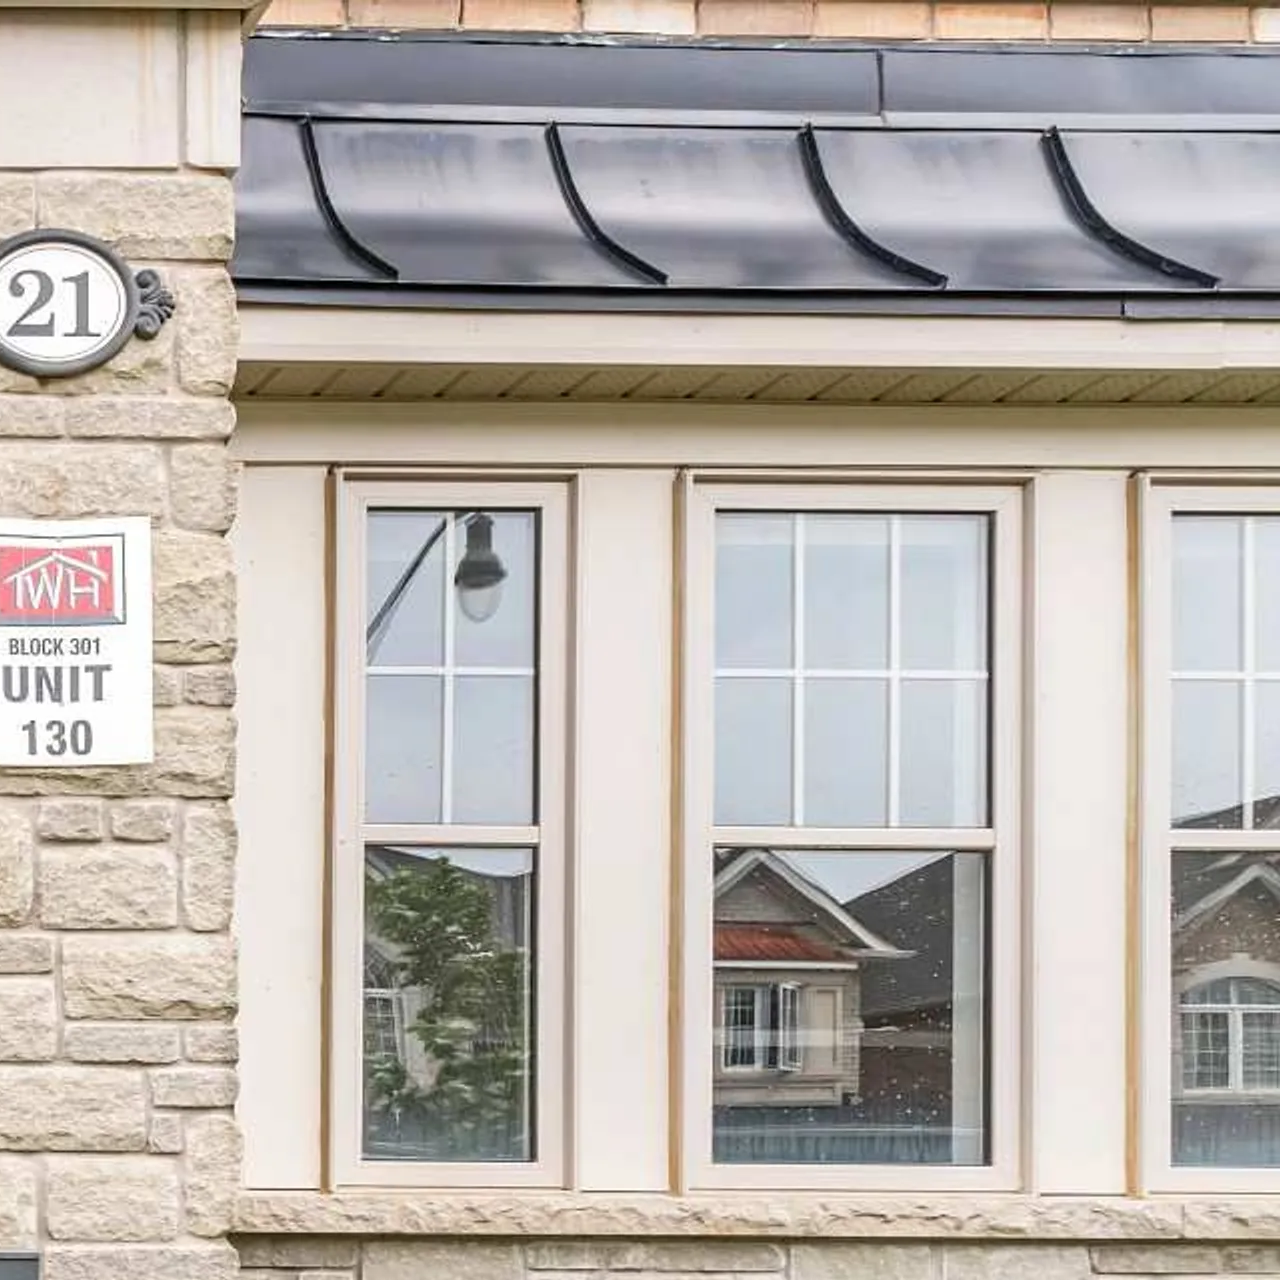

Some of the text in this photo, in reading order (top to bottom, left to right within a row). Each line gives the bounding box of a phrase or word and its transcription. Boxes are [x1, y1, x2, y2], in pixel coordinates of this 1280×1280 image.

[6, 269, 102, 337] 21
[8, 636, 101, 656] BLOCK 301
[1, 664, 113, 704] UNIT
[21, 719, 94, 756] 130
